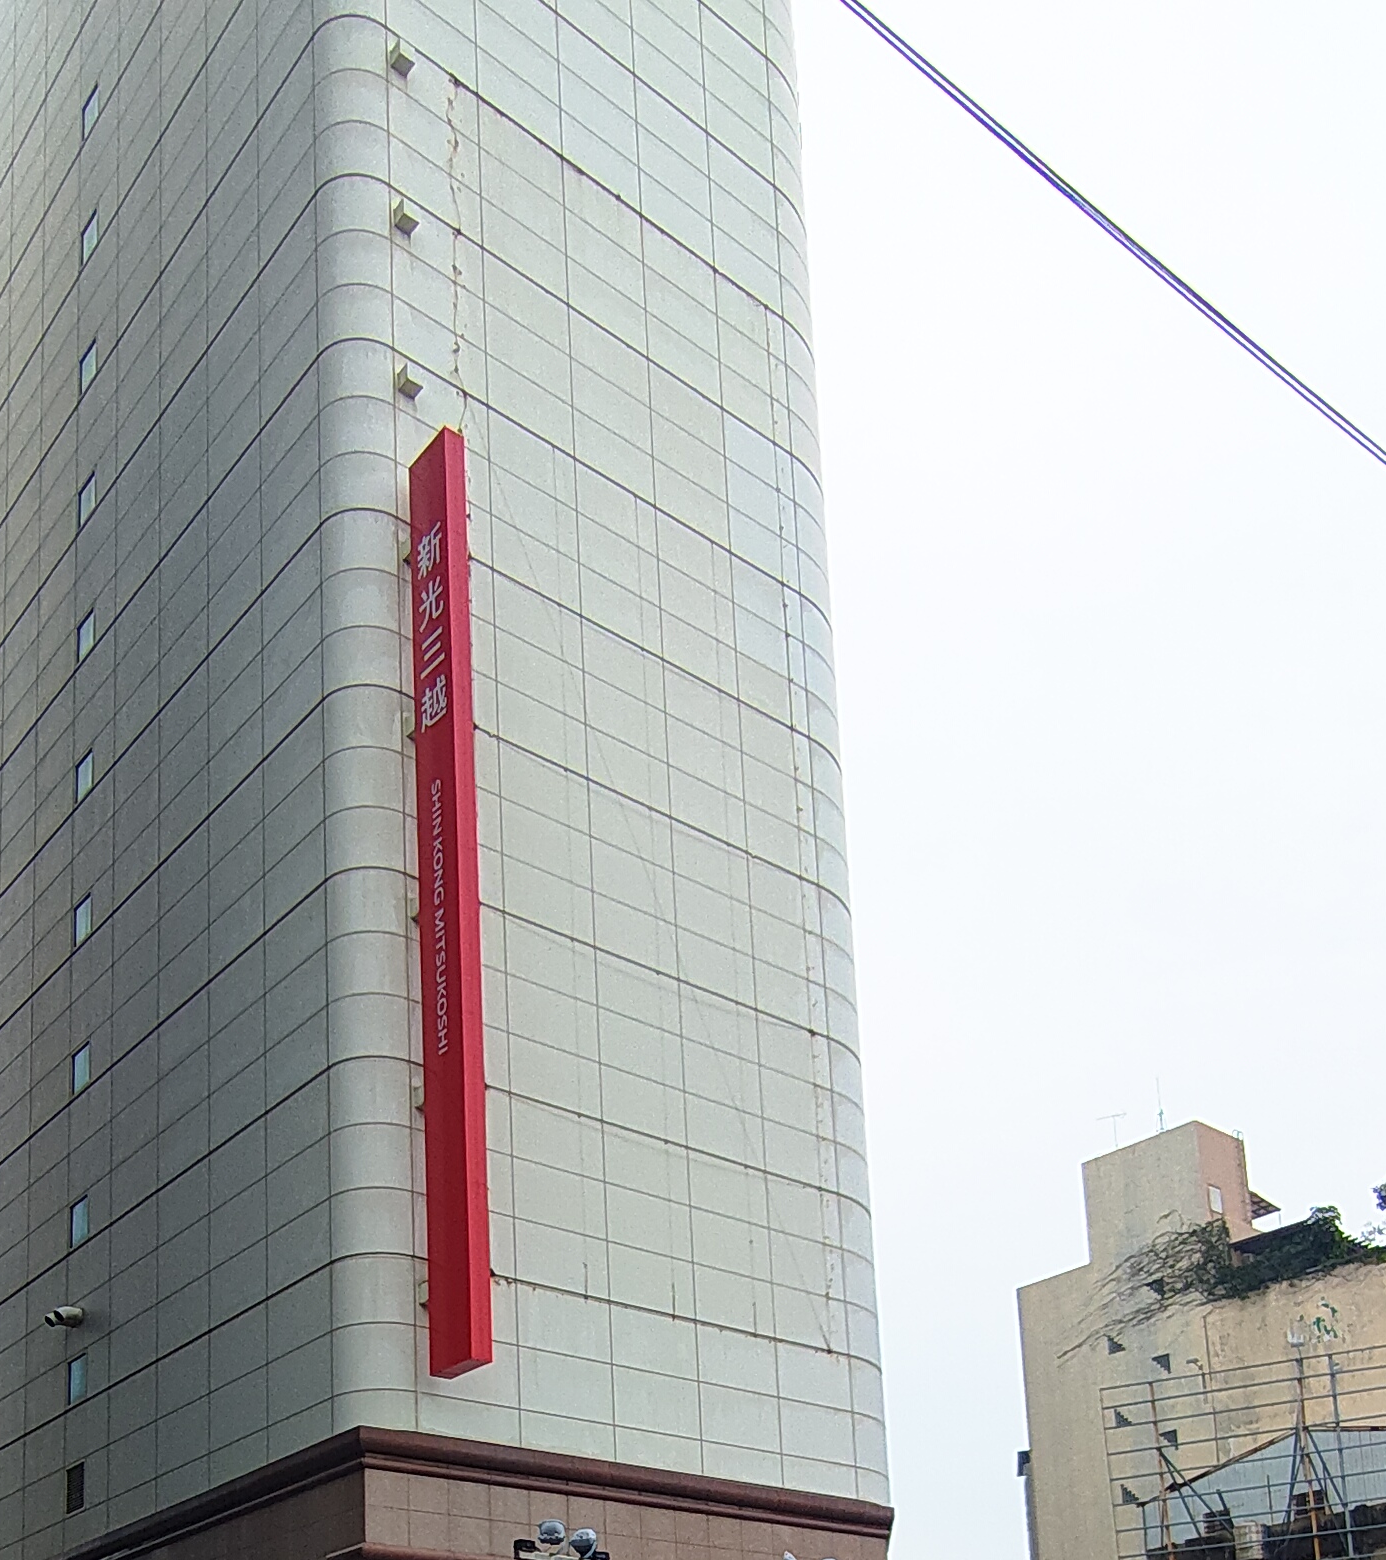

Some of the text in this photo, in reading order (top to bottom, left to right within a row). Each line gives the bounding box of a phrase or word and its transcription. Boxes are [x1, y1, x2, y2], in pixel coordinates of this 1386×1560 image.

[418, 521, 448, 734] 新光三越
[434, 908, 449, 1056] MITSUKOSHI
